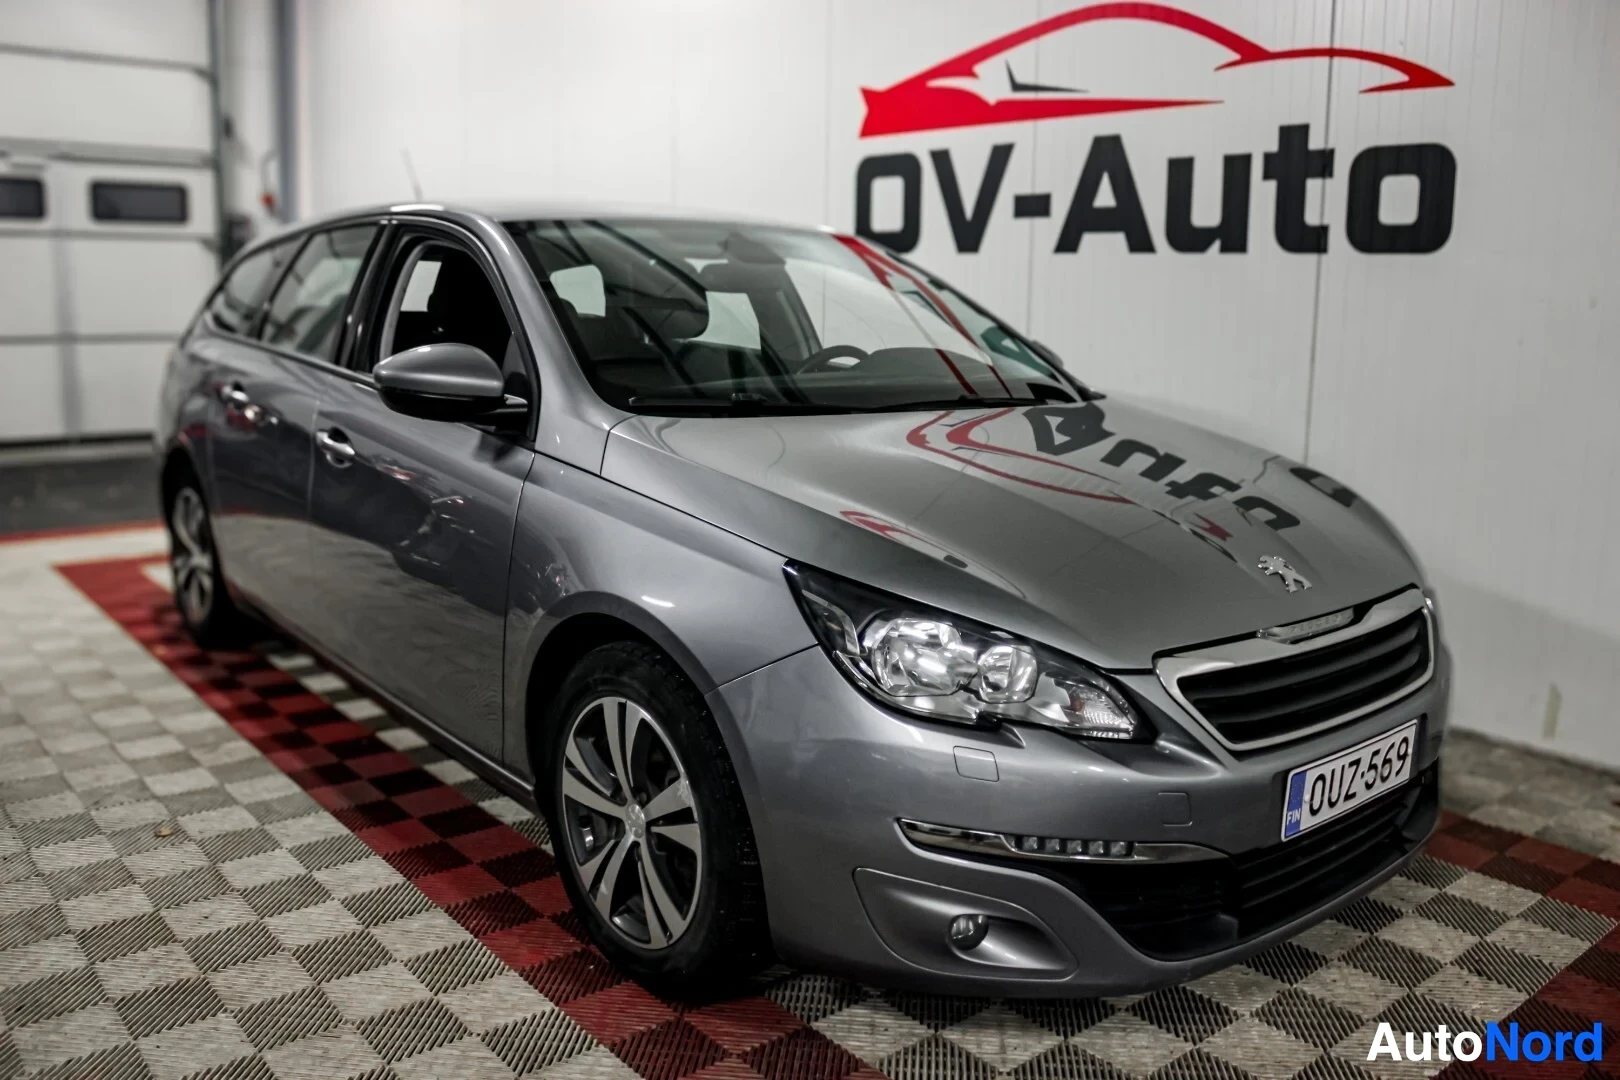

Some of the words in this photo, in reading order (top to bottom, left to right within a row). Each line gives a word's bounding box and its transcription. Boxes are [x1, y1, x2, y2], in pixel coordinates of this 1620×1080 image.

[855, 123, 1458, 254] OV-Auto
[1286, 807, 1302, 827] FIN
[1308, 735, 1409, 817] OUZ-569
